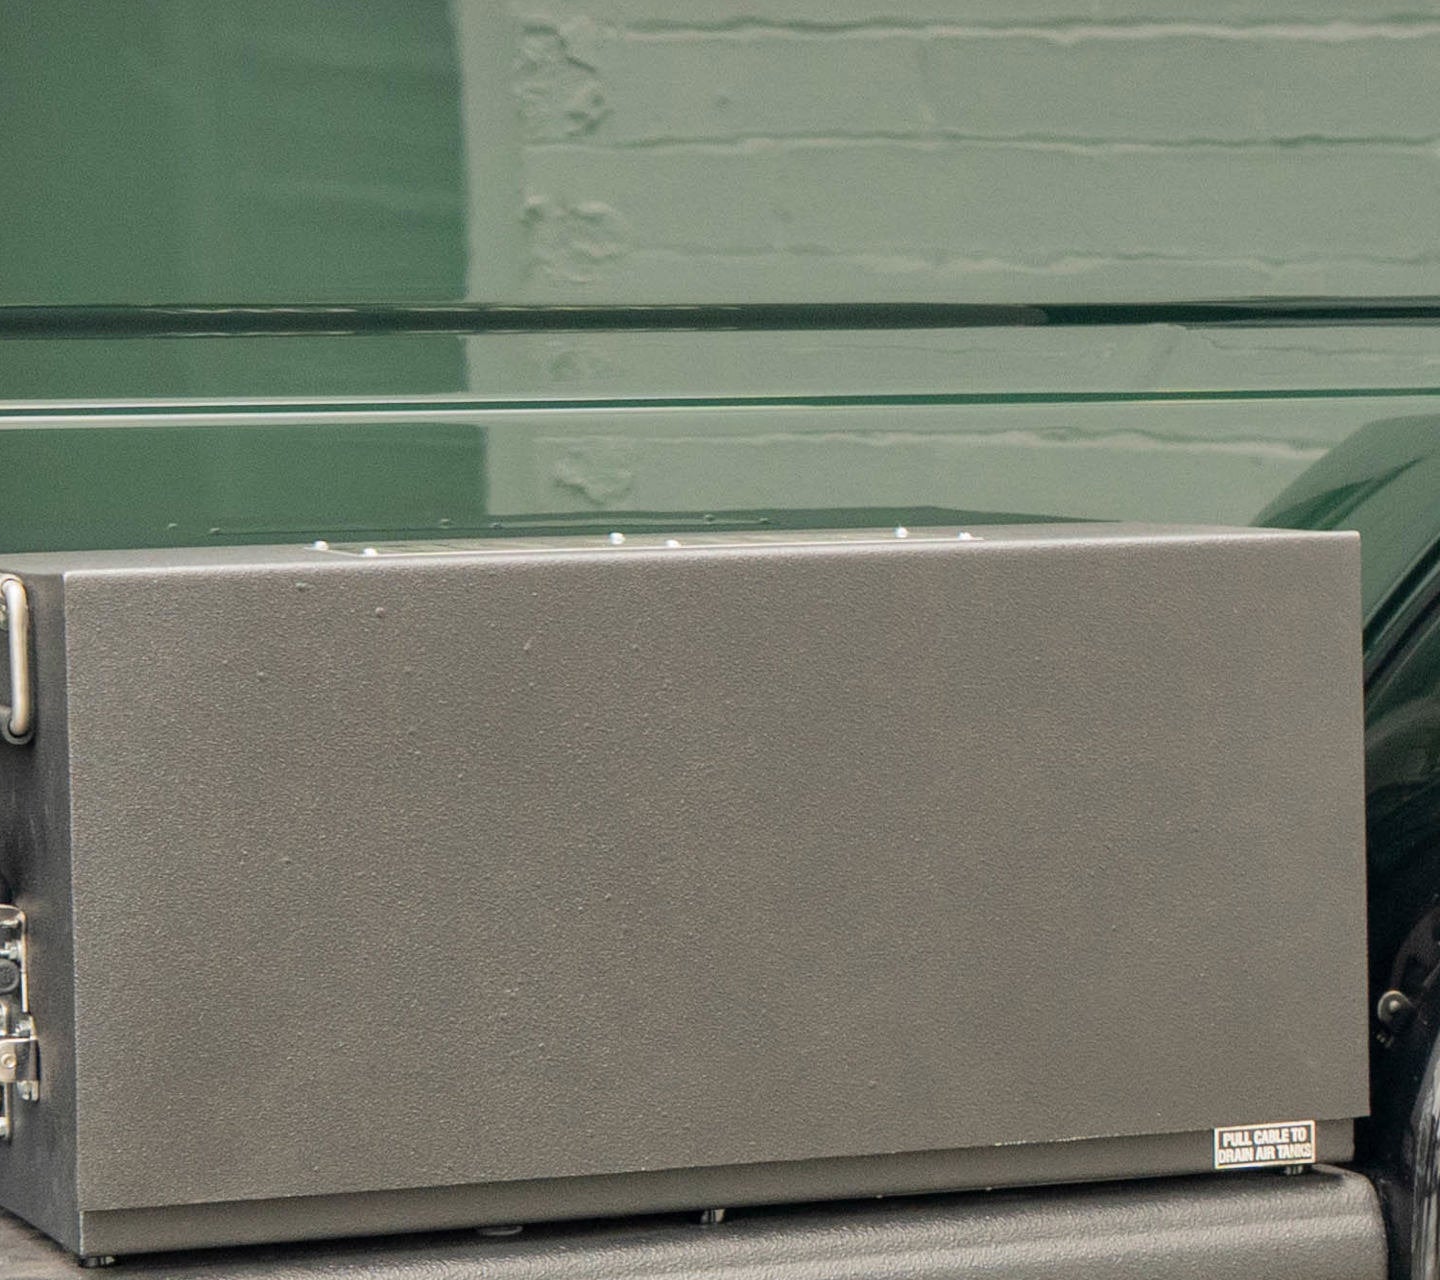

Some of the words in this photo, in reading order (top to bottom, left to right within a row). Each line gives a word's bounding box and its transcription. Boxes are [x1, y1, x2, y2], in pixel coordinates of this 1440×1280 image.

[1223, 1132, 1252, 1147] PULL
[1253, 1130, 1289, 1145] CABLE
[1292, 1127, 1306, 1142] TO
[1218, 1148, 1253, 1163] DRAIN
[1256, 1146, 1275, 1160] AIR
[1277, 1143, 1311, 1158] TANKS
